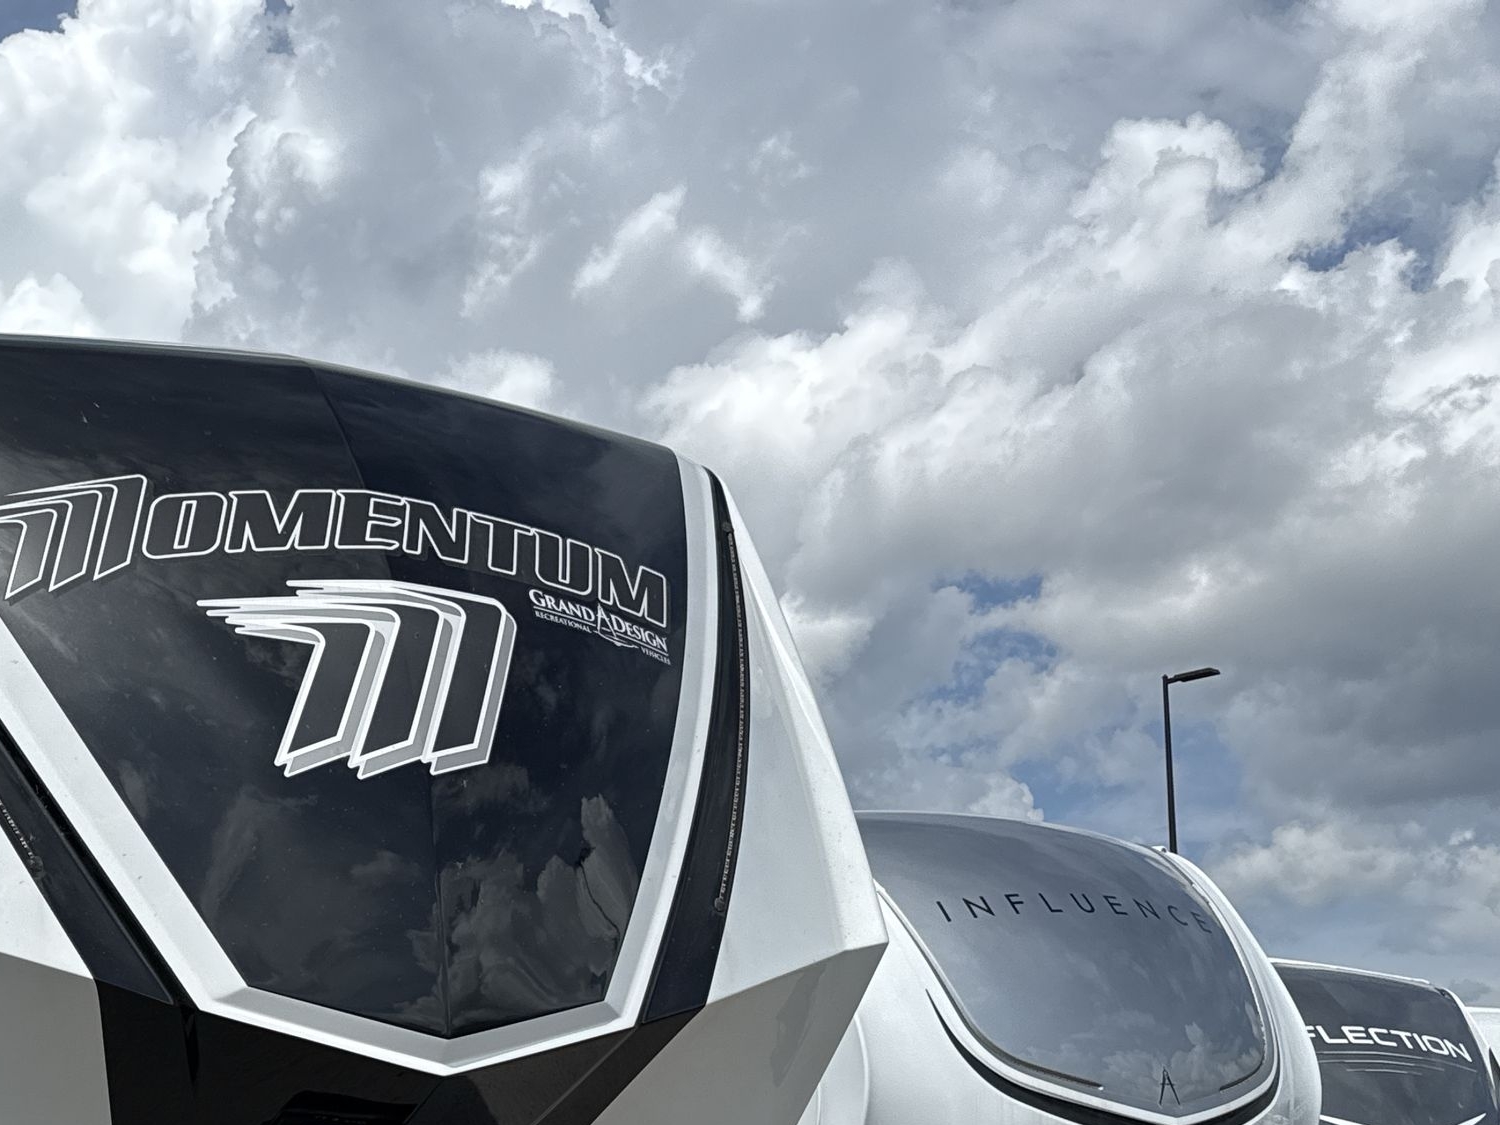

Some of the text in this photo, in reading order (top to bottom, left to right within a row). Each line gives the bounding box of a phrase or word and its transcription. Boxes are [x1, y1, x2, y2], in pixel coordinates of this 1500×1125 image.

[529, 588, 668, 652] GRAND DESIGN
[534, 610, 593, 634] RECREATIONAL
[640, 646, 671, 665] VEHICLES
[935, 892, 1213, 934] INFLUENCE
